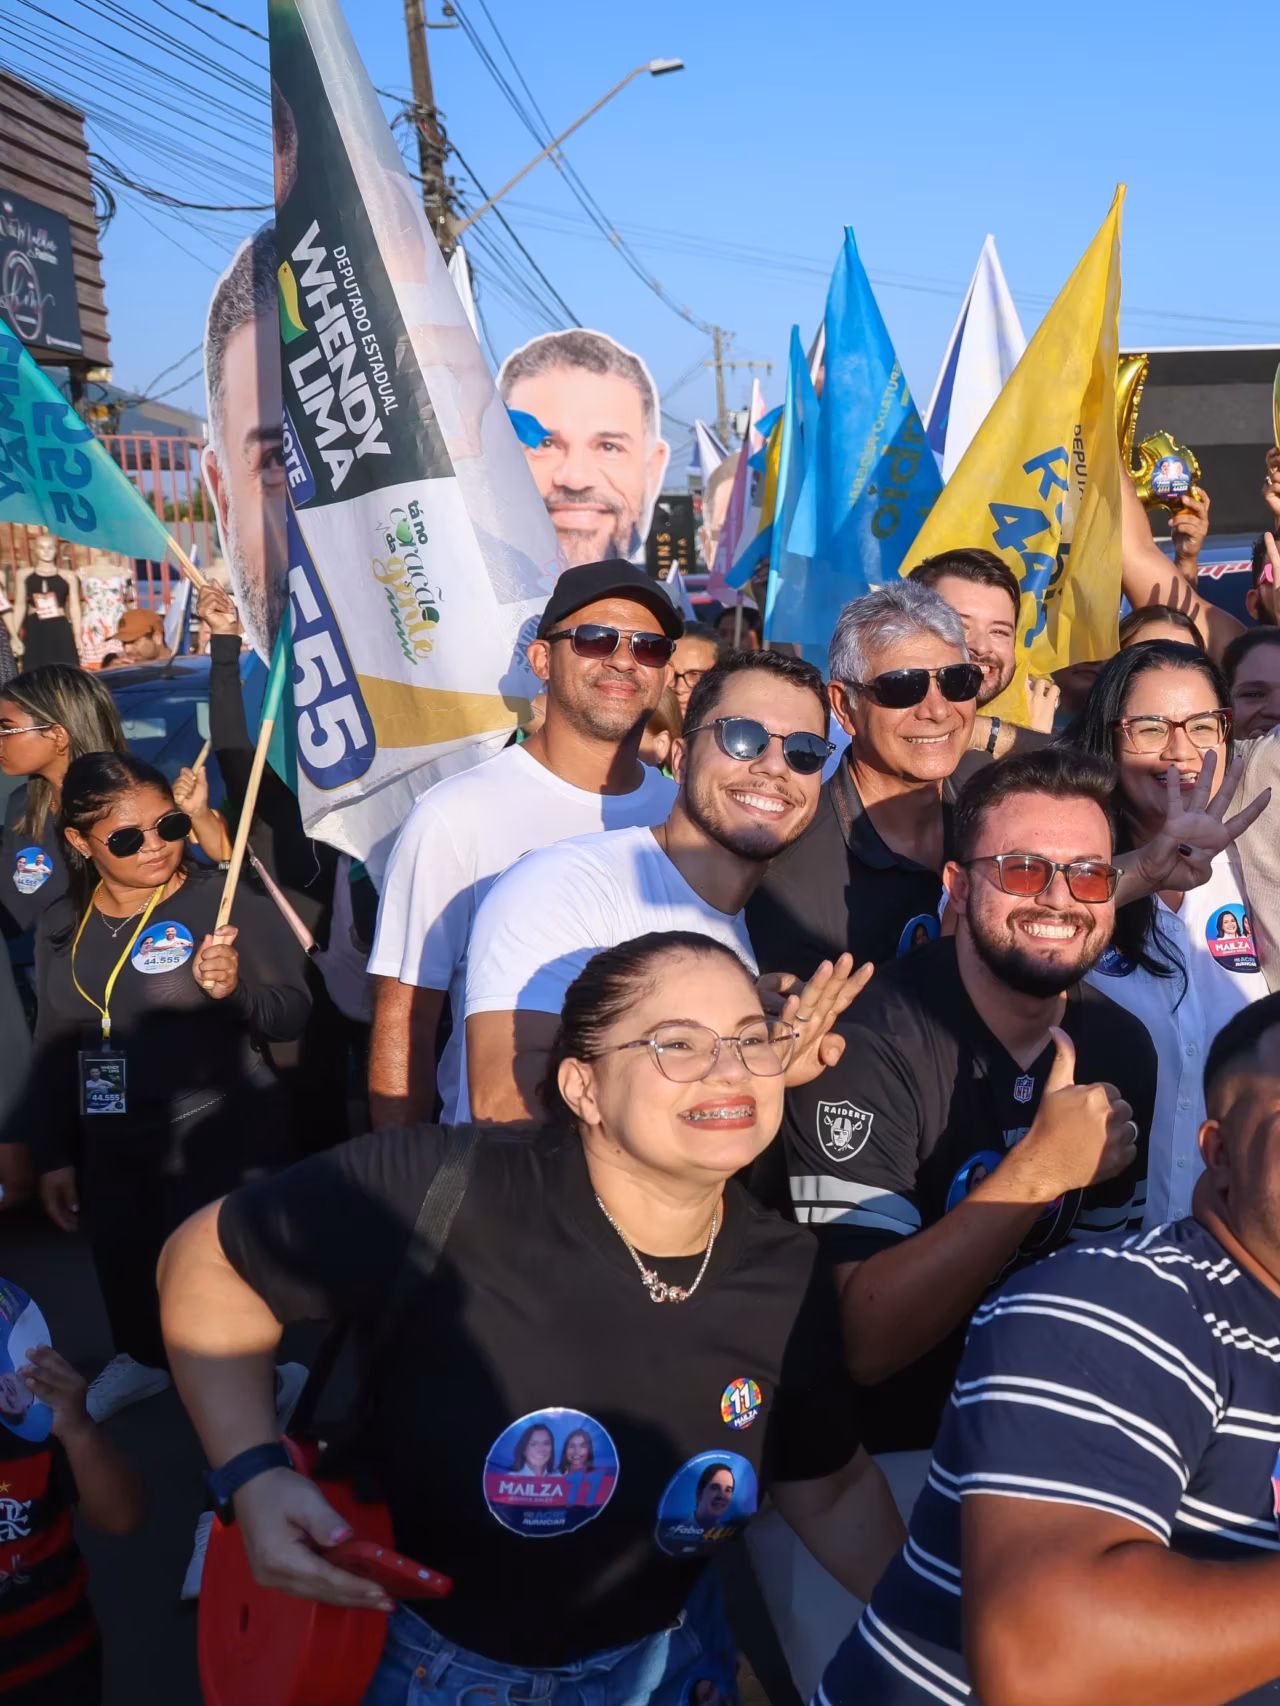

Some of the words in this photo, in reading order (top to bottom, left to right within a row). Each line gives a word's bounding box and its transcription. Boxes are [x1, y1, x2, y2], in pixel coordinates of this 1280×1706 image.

[291, 219, 391, 459] WHENDY
[333, 245, 372, 332] DEPUTADO
[361, 333, 399, 416] ESTADUAL
[288, 346, 355, 492] LIMA
[413, 521, 428, 545] no
[1215, 941, 1250, 952] MAILZA
[144, 956, 180, 966] 44.555
[1015, 1087, 1032, 1100] NFL
[823, 1105, 866, 1121] RAIDERS
[730, 1382, 751, 1414] 11
[734, 1409, 758, 1427] MAILZA
[499, 1480, 563, 1497] MAILZA
[565, 1469, 603, 1505] 11
[675, 1524, 704, 1535] Fabio
